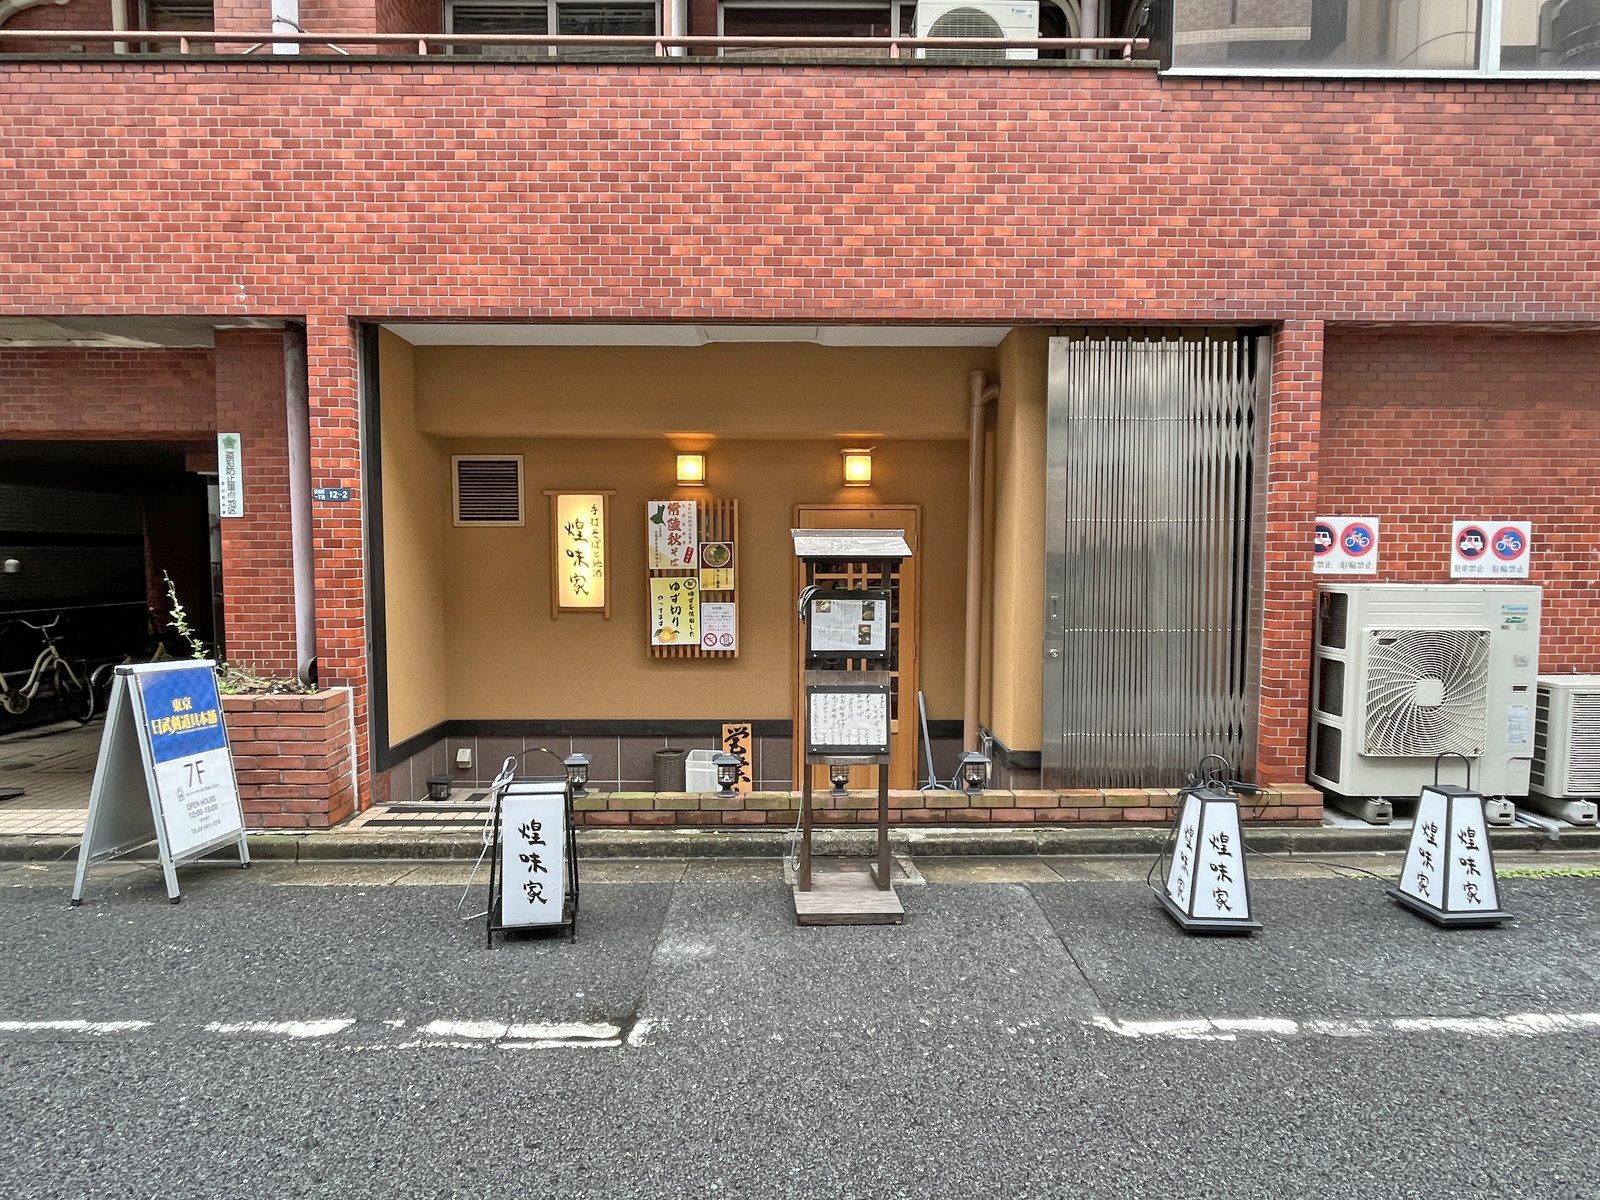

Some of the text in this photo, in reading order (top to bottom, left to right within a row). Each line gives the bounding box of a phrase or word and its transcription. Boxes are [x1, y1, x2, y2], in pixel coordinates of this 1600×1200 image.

[329, 490, 348, 499] 12-2
[564, 518, 590, 596] 煌味家
[667, 502, 682, 566] 常陸秋そば
[1340, 561, 1374, 569] 駐輪禁止
[1454, 564, 1485, 573] 駐車禁止
[1492, 565, 1524, 573] 駐輪禁止
[669, 581, 682, 627] ゆず切り
[172, 696, 192, 712] 東京
[184, 760, 205, 788] 7F
[186, 795, 217, 811] OPEN HOURS
[518, 818, 548, 905] 煌味家
[1176, 825, 1194, 903] 煌味家
[1209, 831, 1233, 912] 煌味家
[1417, 821, 1439, 898] 煌味家
[1457, 826, 1482, 904] 煌味家
